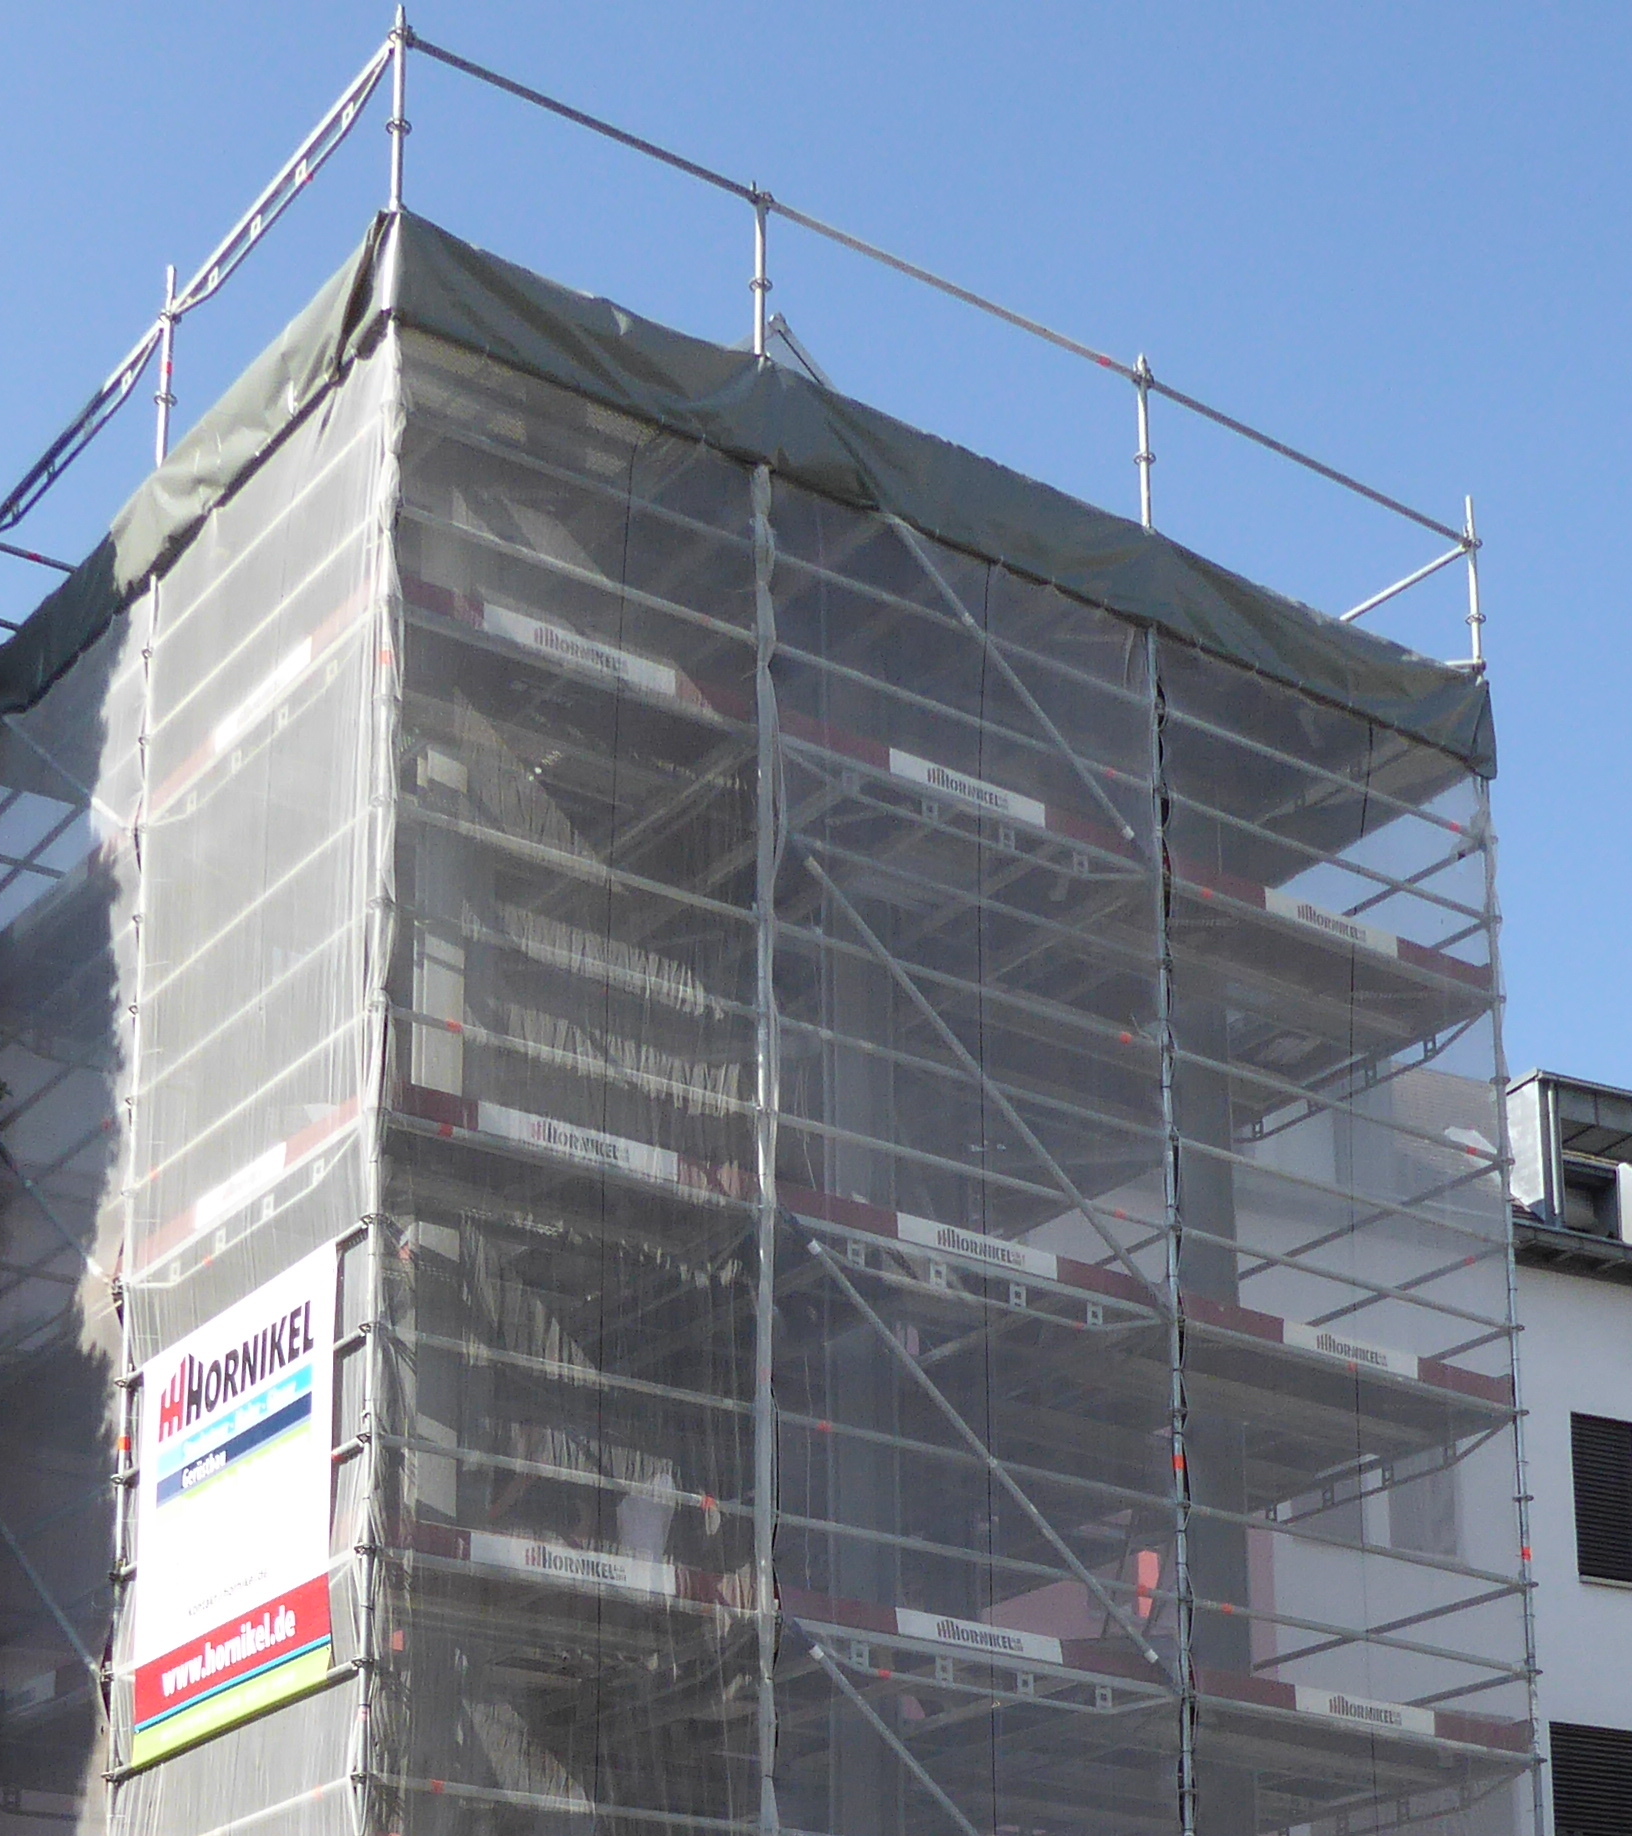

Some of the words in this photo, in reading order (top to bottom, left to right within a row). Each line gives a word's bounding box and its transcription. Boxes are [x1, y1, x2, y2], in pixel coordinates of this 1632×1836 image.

[952, 1230, 1012, 1263] HORNIKEL
[186, 1300, 314, 1426] HORNIKEL
[181, 1450, 227, 1489] Gerüstbau
[542, 1546, 615, 1580] HORNIKEL
[162, 1604, 296, 1697] www.hornikel.de
[951, 1621, 1014, 1650] HORNIKEL
